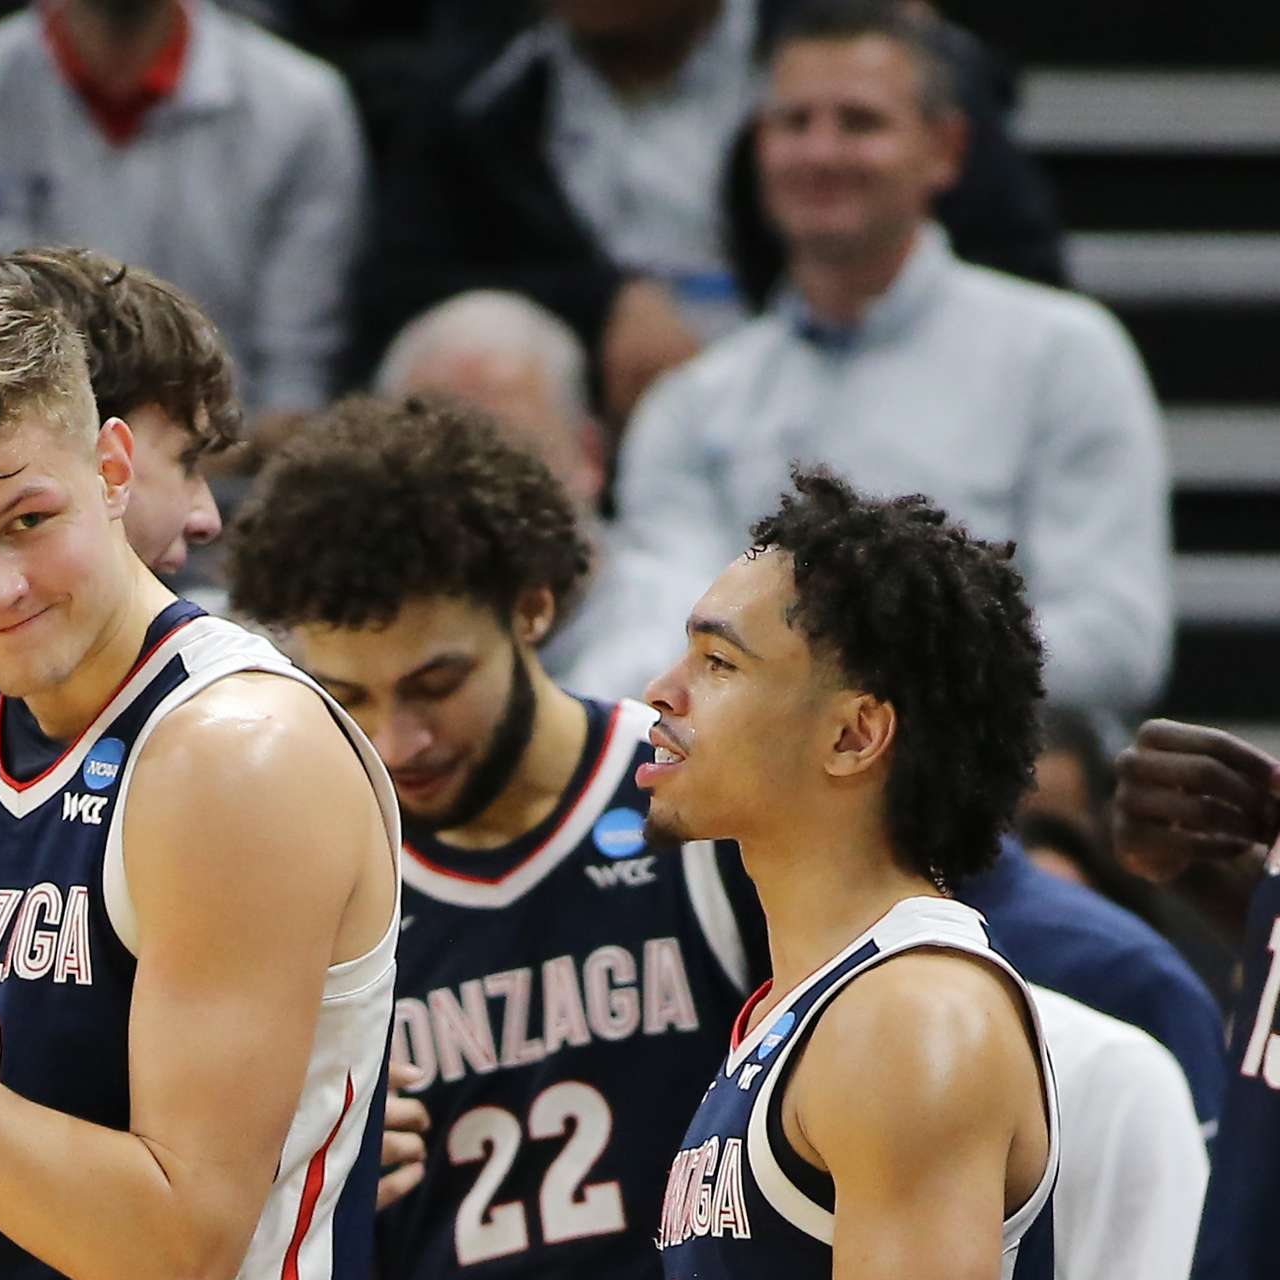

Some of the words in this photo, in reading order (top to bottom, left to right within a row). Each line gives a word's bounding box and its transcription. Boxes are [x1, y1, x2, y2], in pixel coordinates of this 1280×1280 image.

[62, 791, 108, 825] WCC
[392, 936, 700, 1092] ONZAGA
[447, 1079, 627, 1267] 22
